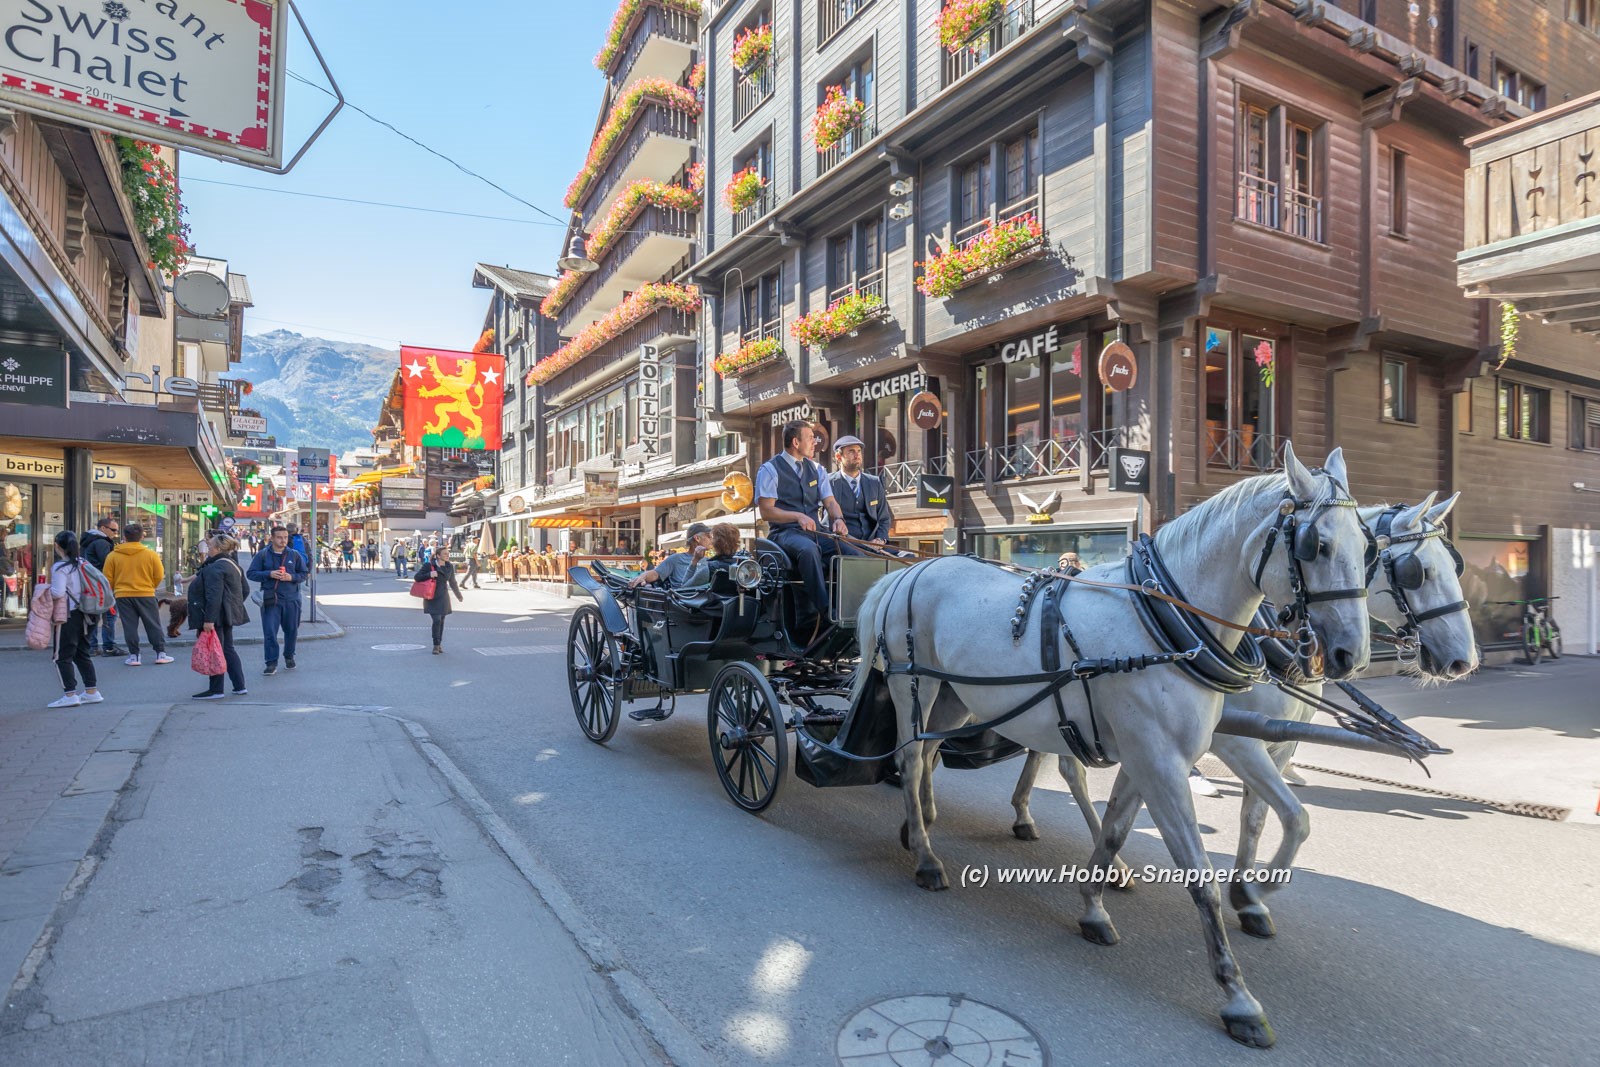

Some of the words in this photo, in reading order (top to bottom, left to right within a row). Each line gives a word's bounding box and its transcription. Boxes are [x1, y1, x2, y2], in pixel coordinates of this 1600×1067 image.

[20, 0, 177, 62] Swiss
[140, 0, 225, 50] ant
[4, 24, 188, 103] Chalet
[85, 85, 100, 98] 20
[103, 91, 114, 101] m
[1001, 324, 1059, 364] CAFÉ
[4, 373, 54, 387] PHILIPPE
[1109, 363, 1129, 377] fuchs
[642, 345, 658, 454] POLLUX
[852, 371, 925, 405] BÄCKEREI
[233, 417, 265, 425] GLACIER
[771, 403, 811, 427] BISTRO
[917, 408, 935, 420] fuchs
[95, 466, 117, 480] pb
